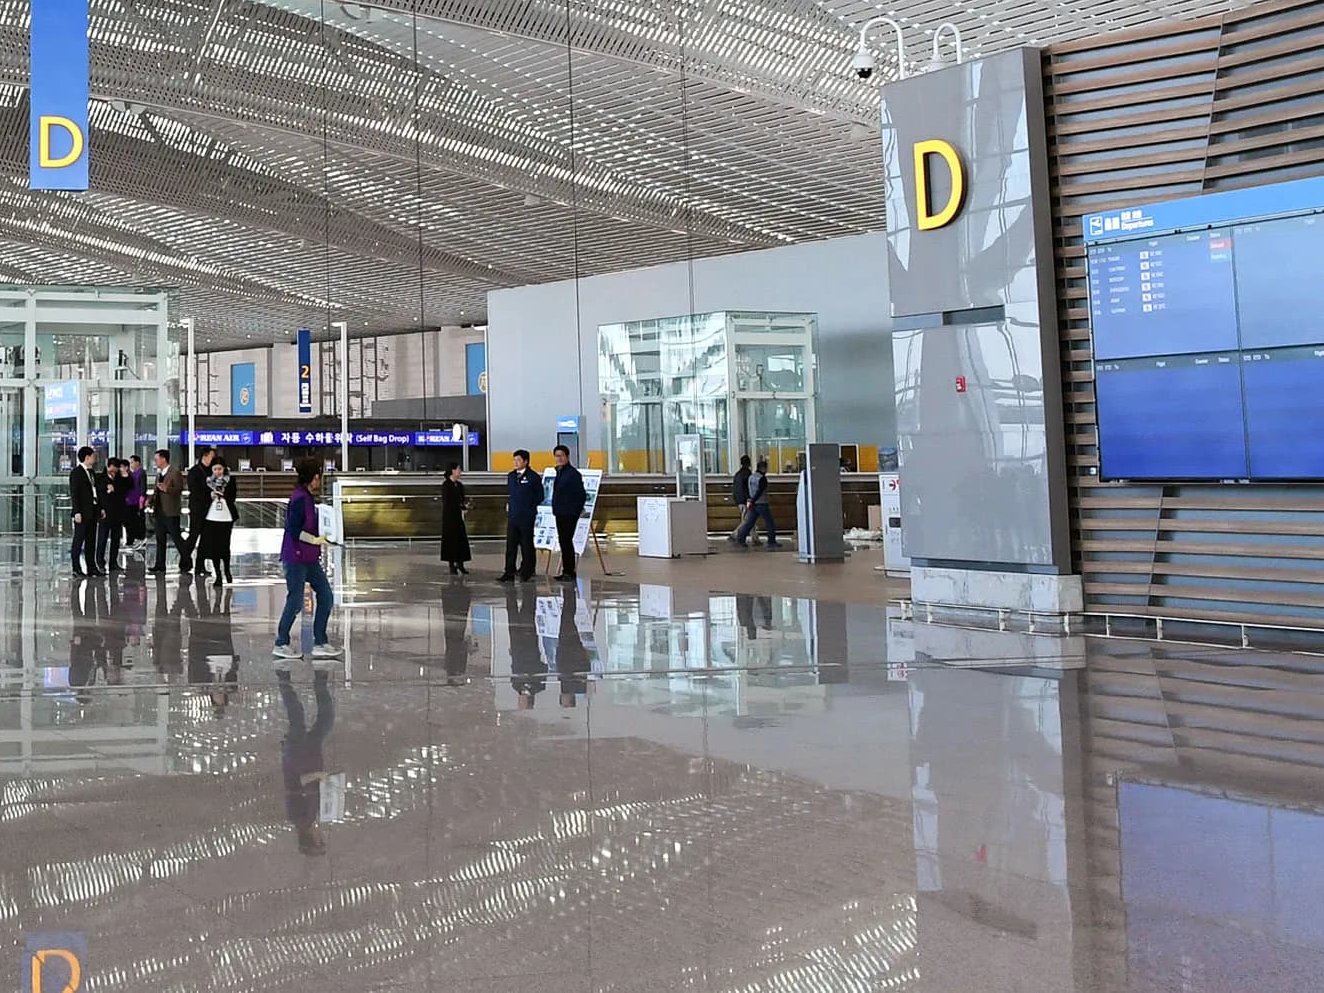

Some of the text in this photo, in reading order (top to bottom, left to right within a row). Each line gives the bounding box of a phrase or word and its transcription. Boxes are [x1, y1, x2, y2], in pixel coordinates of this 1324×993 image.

[39, 115, 84, 168] D
[913, 139, 964, 231] D
[301, 365, 310, 379] 2
[223, 434, 240, 442] AIR
[373, 434, 387, 444] Bag
[388, 434, 410, 444] Drop)
